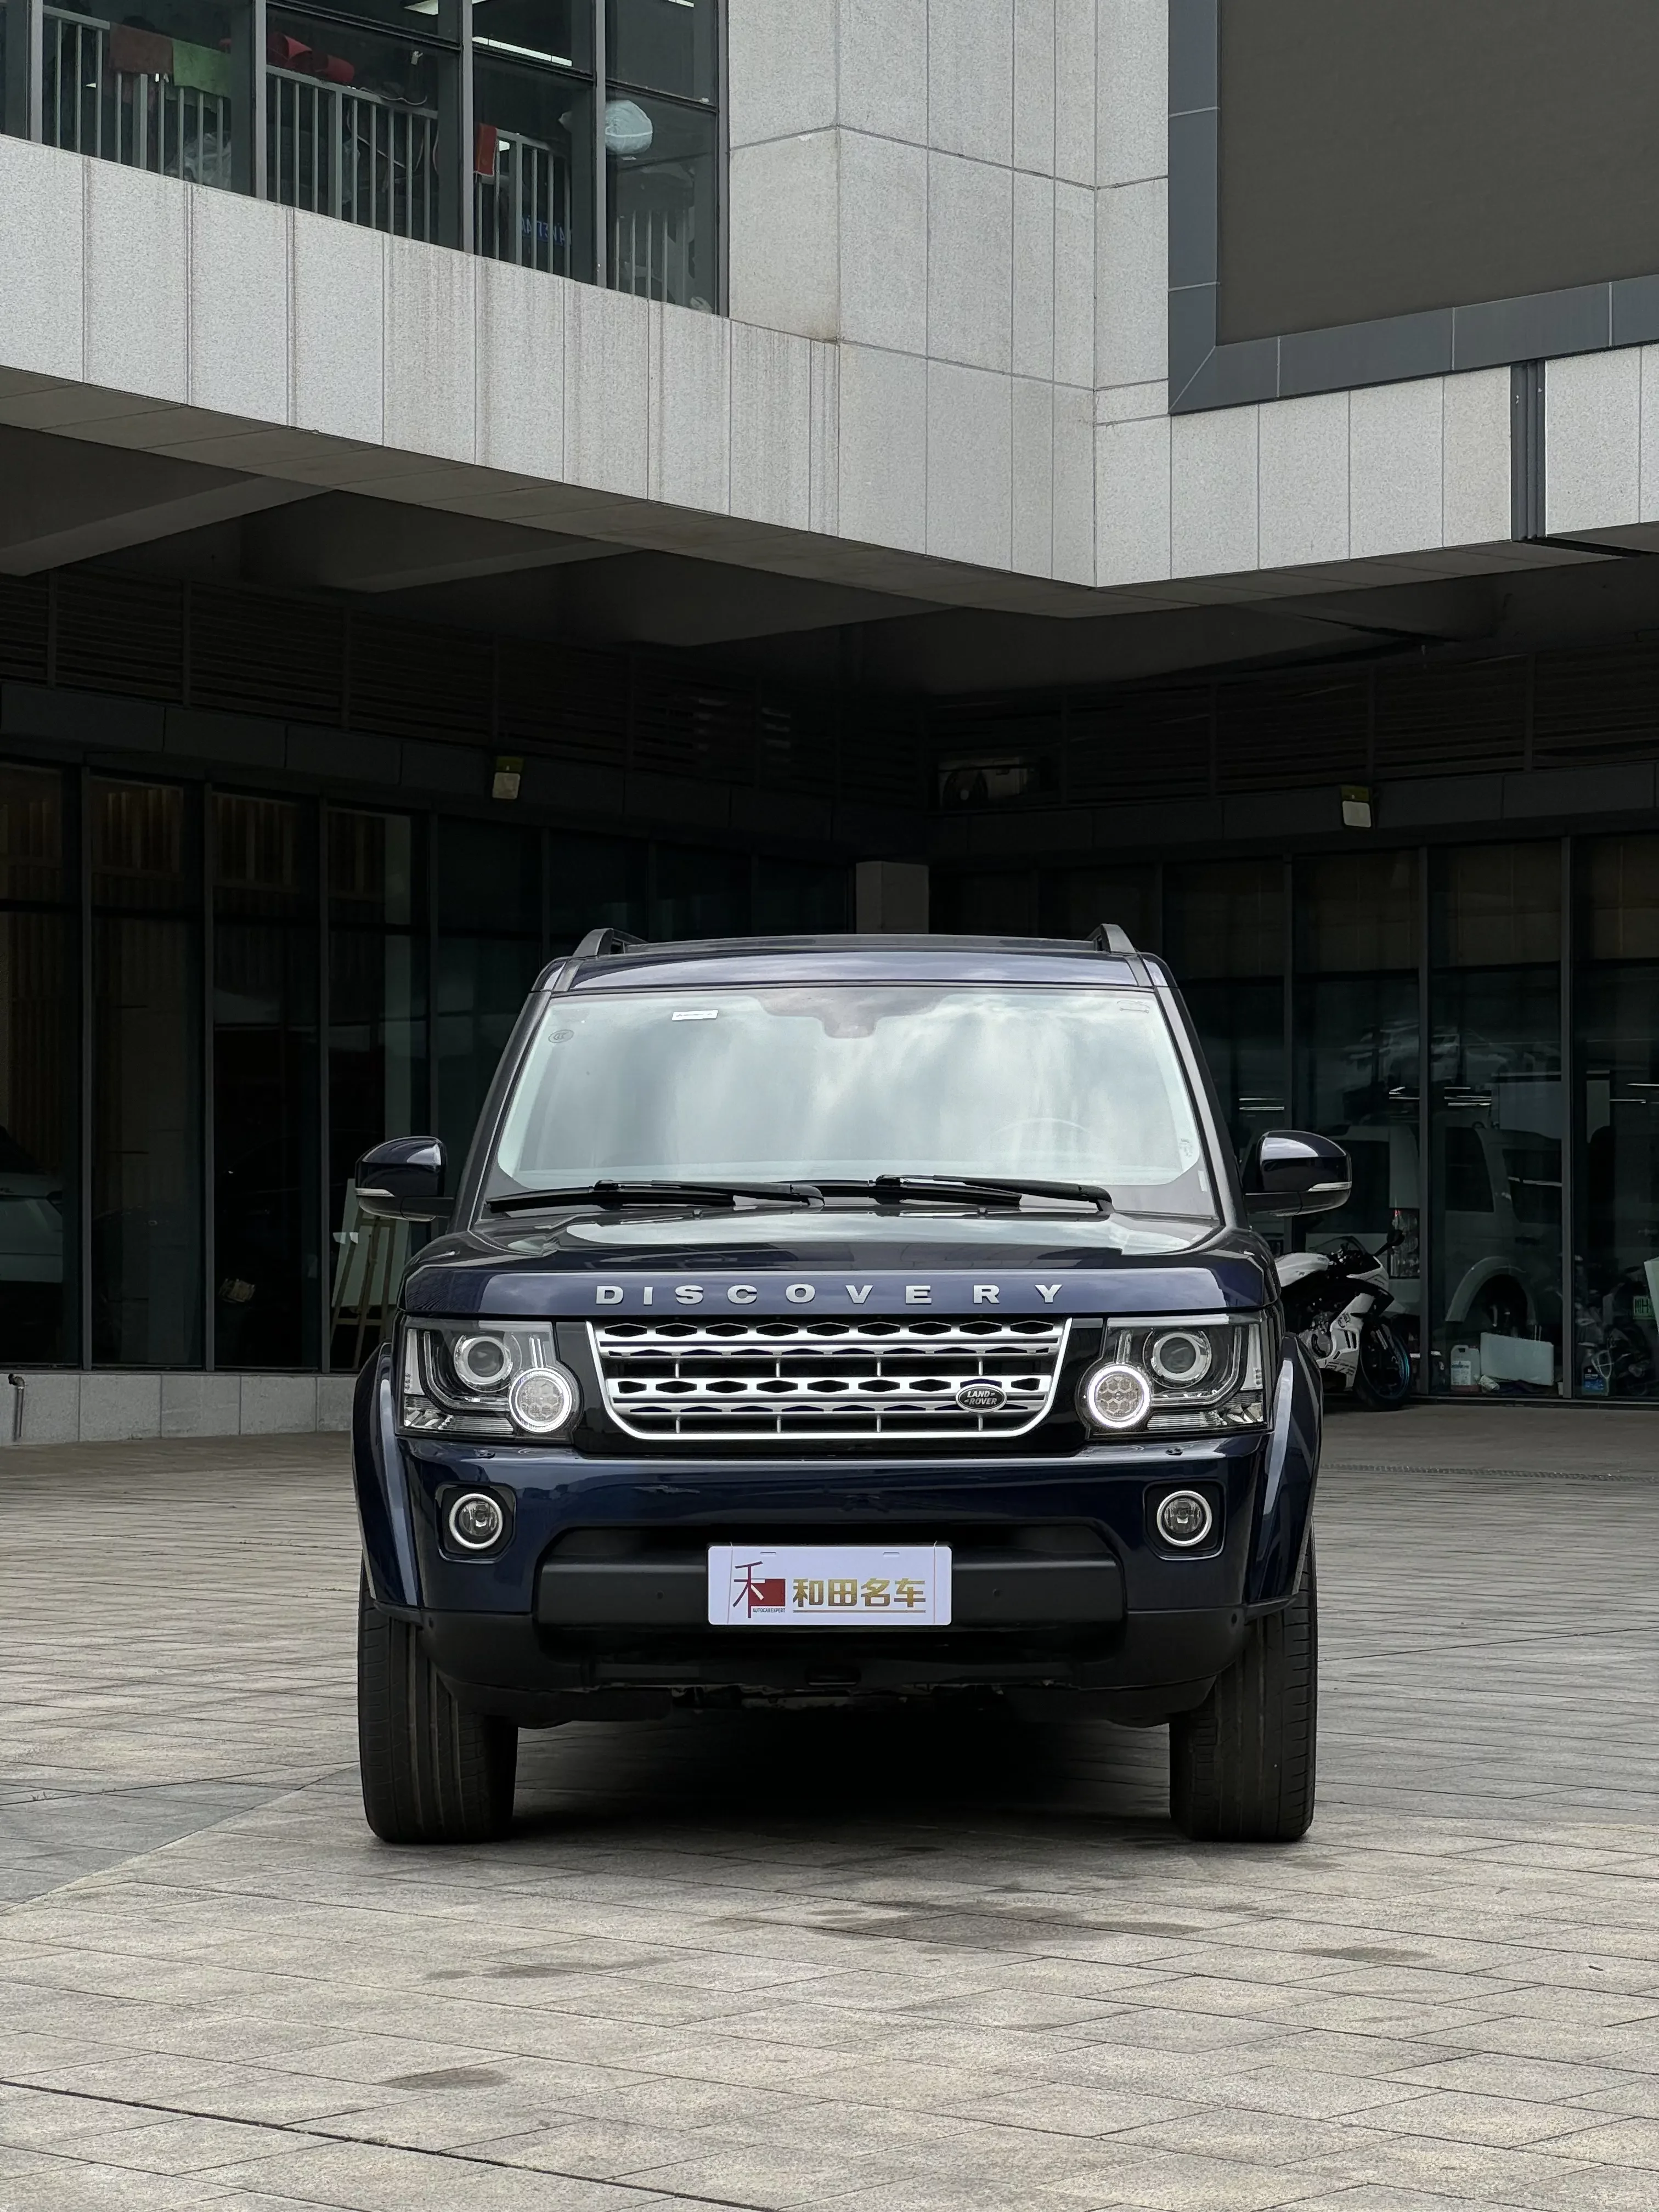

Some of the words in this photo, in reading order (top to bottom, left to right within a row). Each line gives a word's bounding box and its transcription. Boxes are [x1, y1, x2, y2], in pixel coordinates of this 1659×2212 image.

[596, 1283, 1063, 1306] DISCOVERY
[792, 1577, 926, 1608] 和田名车
